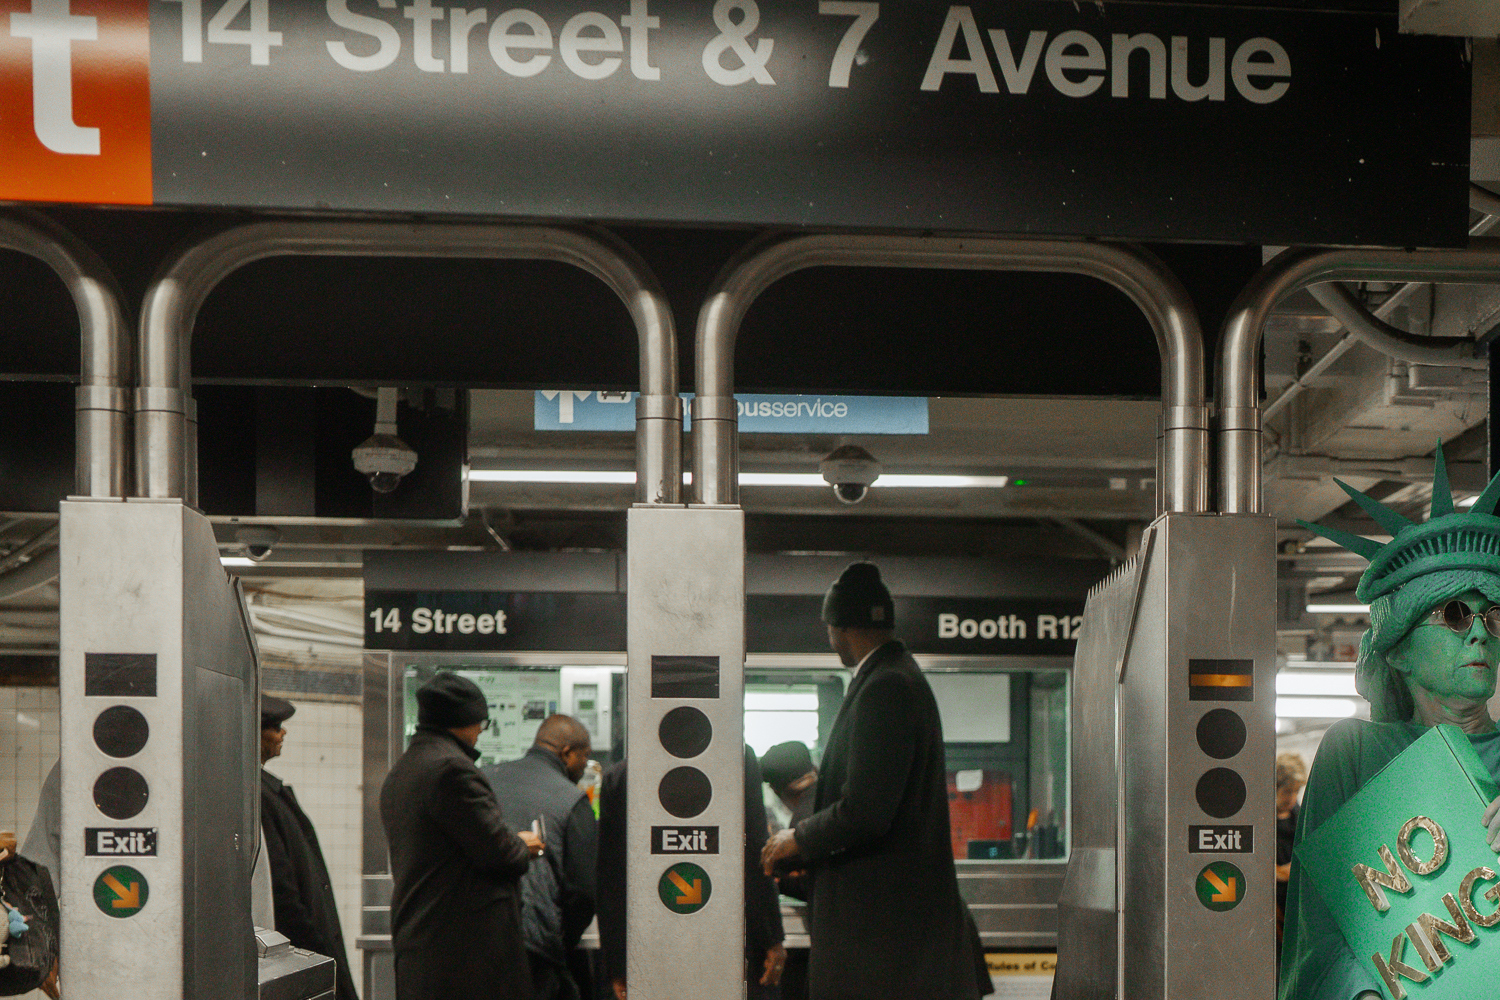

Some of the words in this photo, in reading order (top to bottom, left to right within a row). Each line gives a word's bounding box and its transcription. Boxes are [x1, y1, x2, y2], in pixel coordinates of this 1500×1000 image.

[161, 0, 283, 66] 14
[325, 0, 661, 81] Street
[702, 0, 777, 86] &
[818, 1, 880, 88] 7
[920, 5, 1292, 105] Avenue
[369, 607, 402, 633] 14
[411, 607, 508, 635] Street
[938, 612, 1027, 640] Booth
[97, 831, 149, 853] Exit
[662, 829, 708, 851] Exit
[1198, 829, 1242, 850] Exit
[1351, 815, 1450, 913] NO
